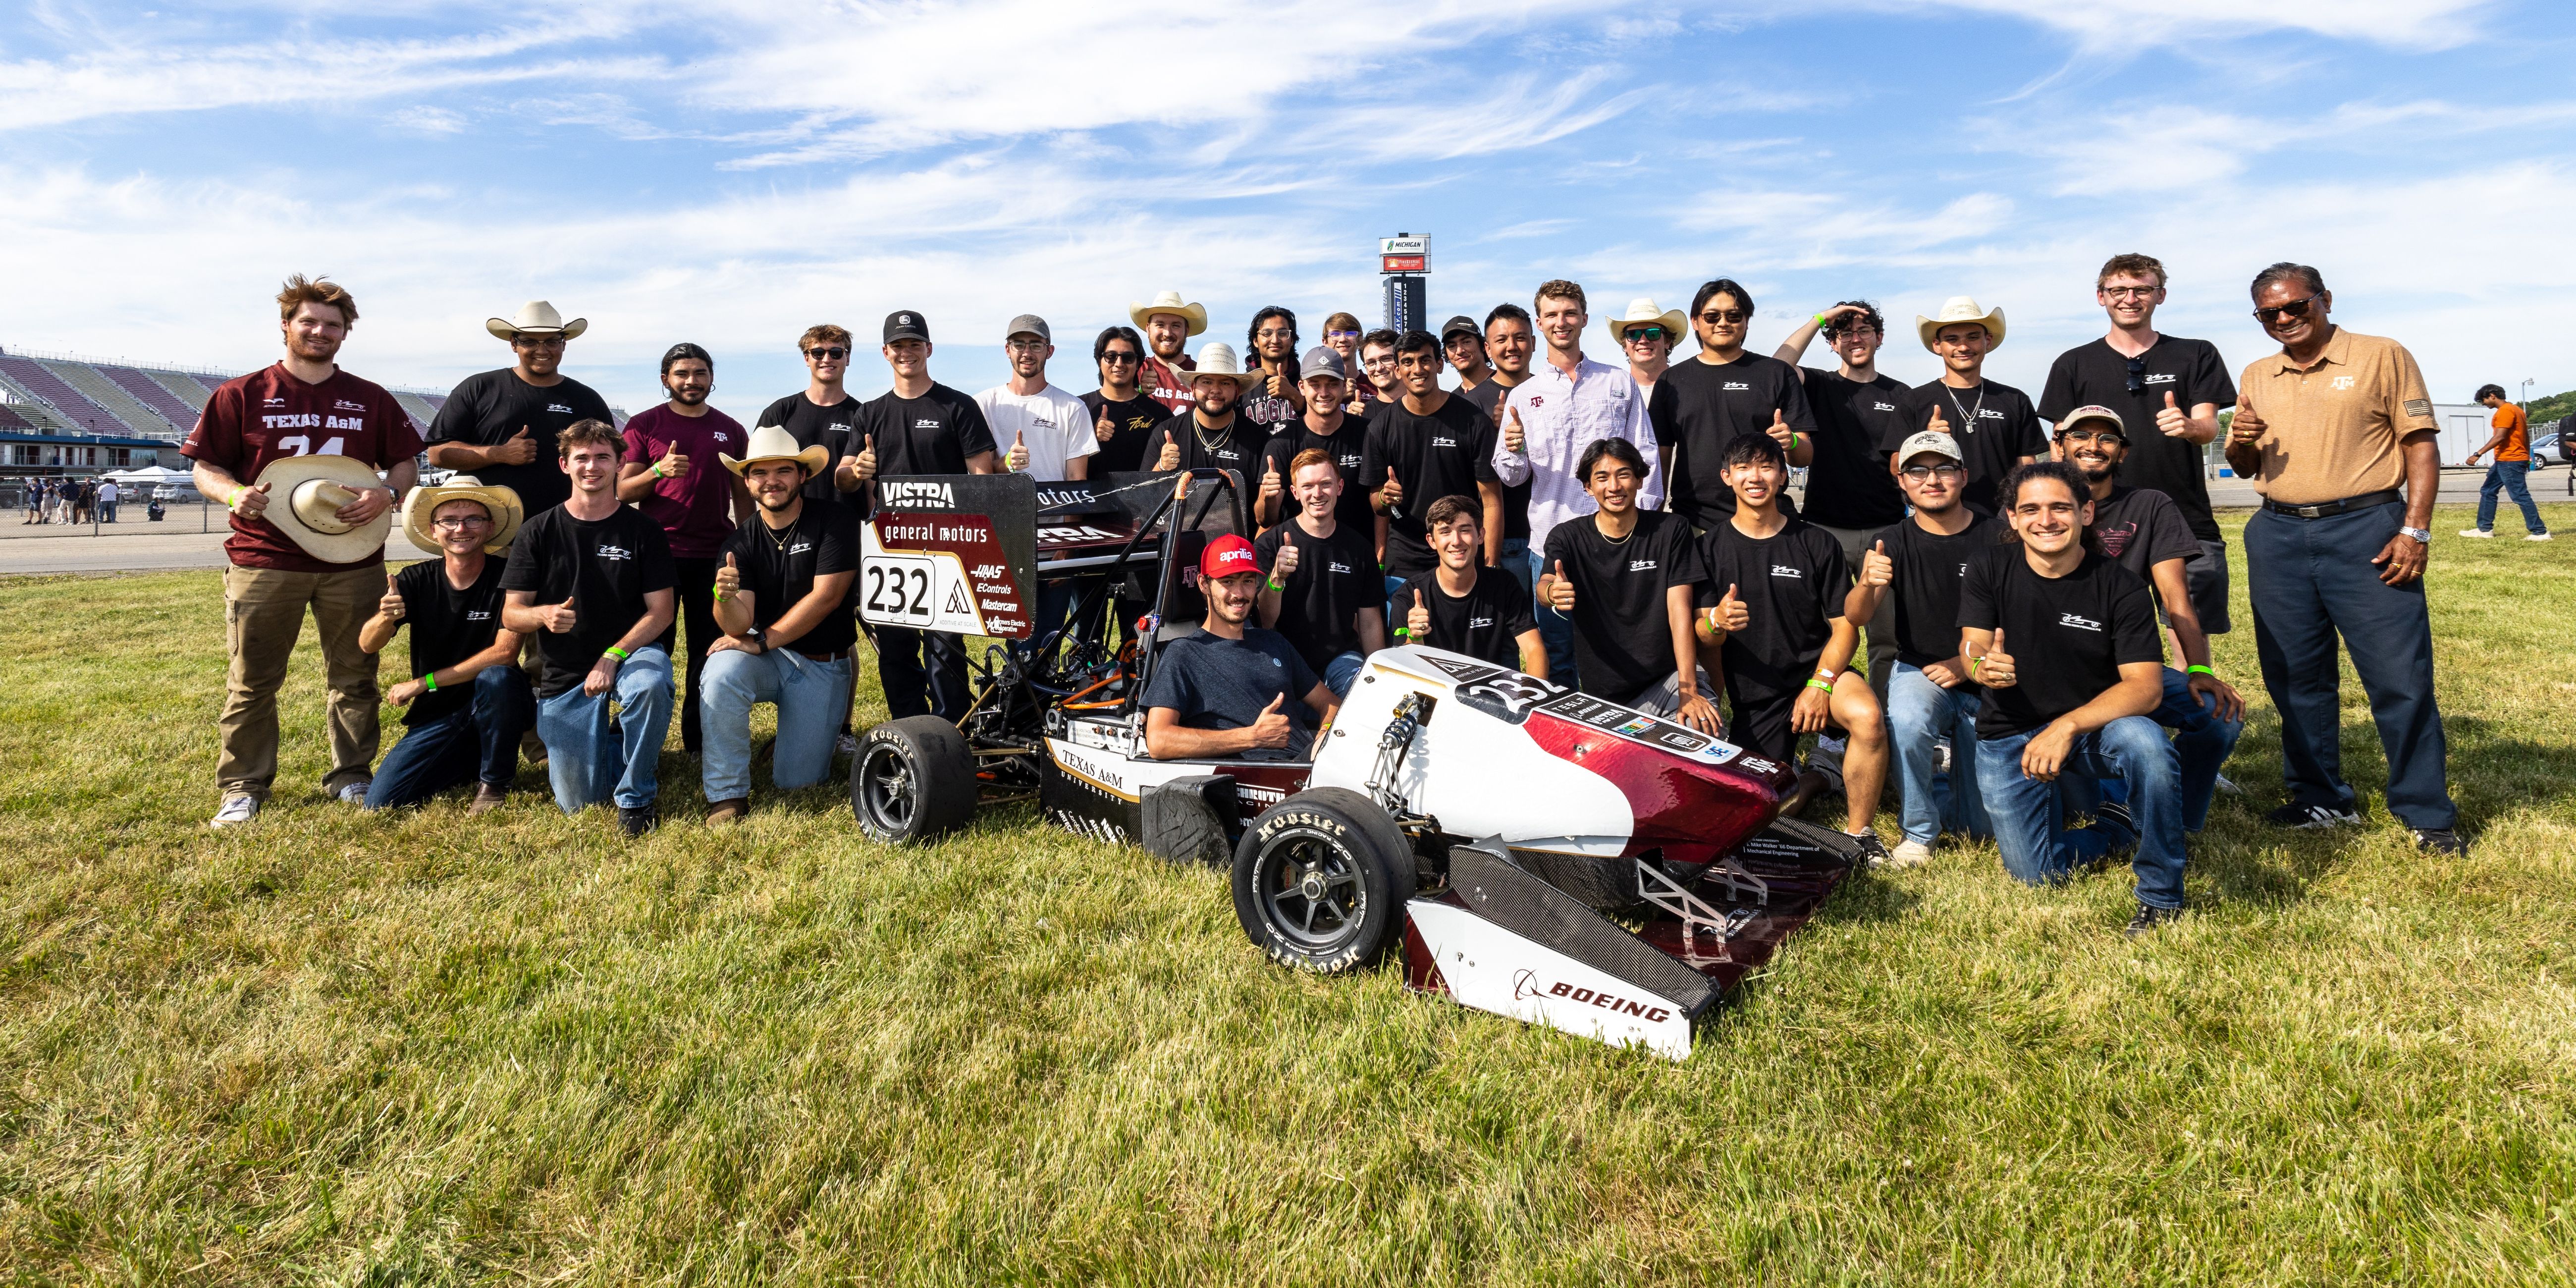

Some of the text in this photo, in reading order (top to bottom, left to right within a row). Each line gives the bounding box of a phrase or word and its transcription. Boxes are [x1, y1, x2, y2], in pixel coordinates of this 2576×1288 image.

[1152, 387, 1173, 399] XAS
[1246, 399, 1296, 425] AGGIE
[262, 413, 363, 431] TEXAS A&M
[1127, 416, 1154, 431] Ford
[882, 483, 955, 508] VISTRA
[1037, 488, 1096, 505] otors
[885, 523, 987, 543] general motors
[1220, 548, 1252, 562] aprilia
[970, 564, 1005, 579] HAAS
[867, 566, 928, 616] 232
[976, 583, 1012, 594] EControls
[981, 598, 1018, 612] Mastercam
[1470, 673, 1569, 714] 232
[1551, 697, 1589, 712] TESLA
[1578, 702, 1602, 715] BOEING
[1586, 709, 1627, 725] VISTRA
[1063, 750, 1123, 789] TEXAS A&M
[1061, 771, 1123, 805] UNIVERSITY
[1237, 787, 1286, 803] CHROTH
[1058, 810, 1074, 833] AIRTECH
[1256, 812, 1346, 841] Hoosier
[1101, 818, 1119, 845] NSK
[1307, 829, 1332, 842] RACING
[1285, 942, 1310, 955] RACING
[1549, 981, 1670, 1023] BOEING
